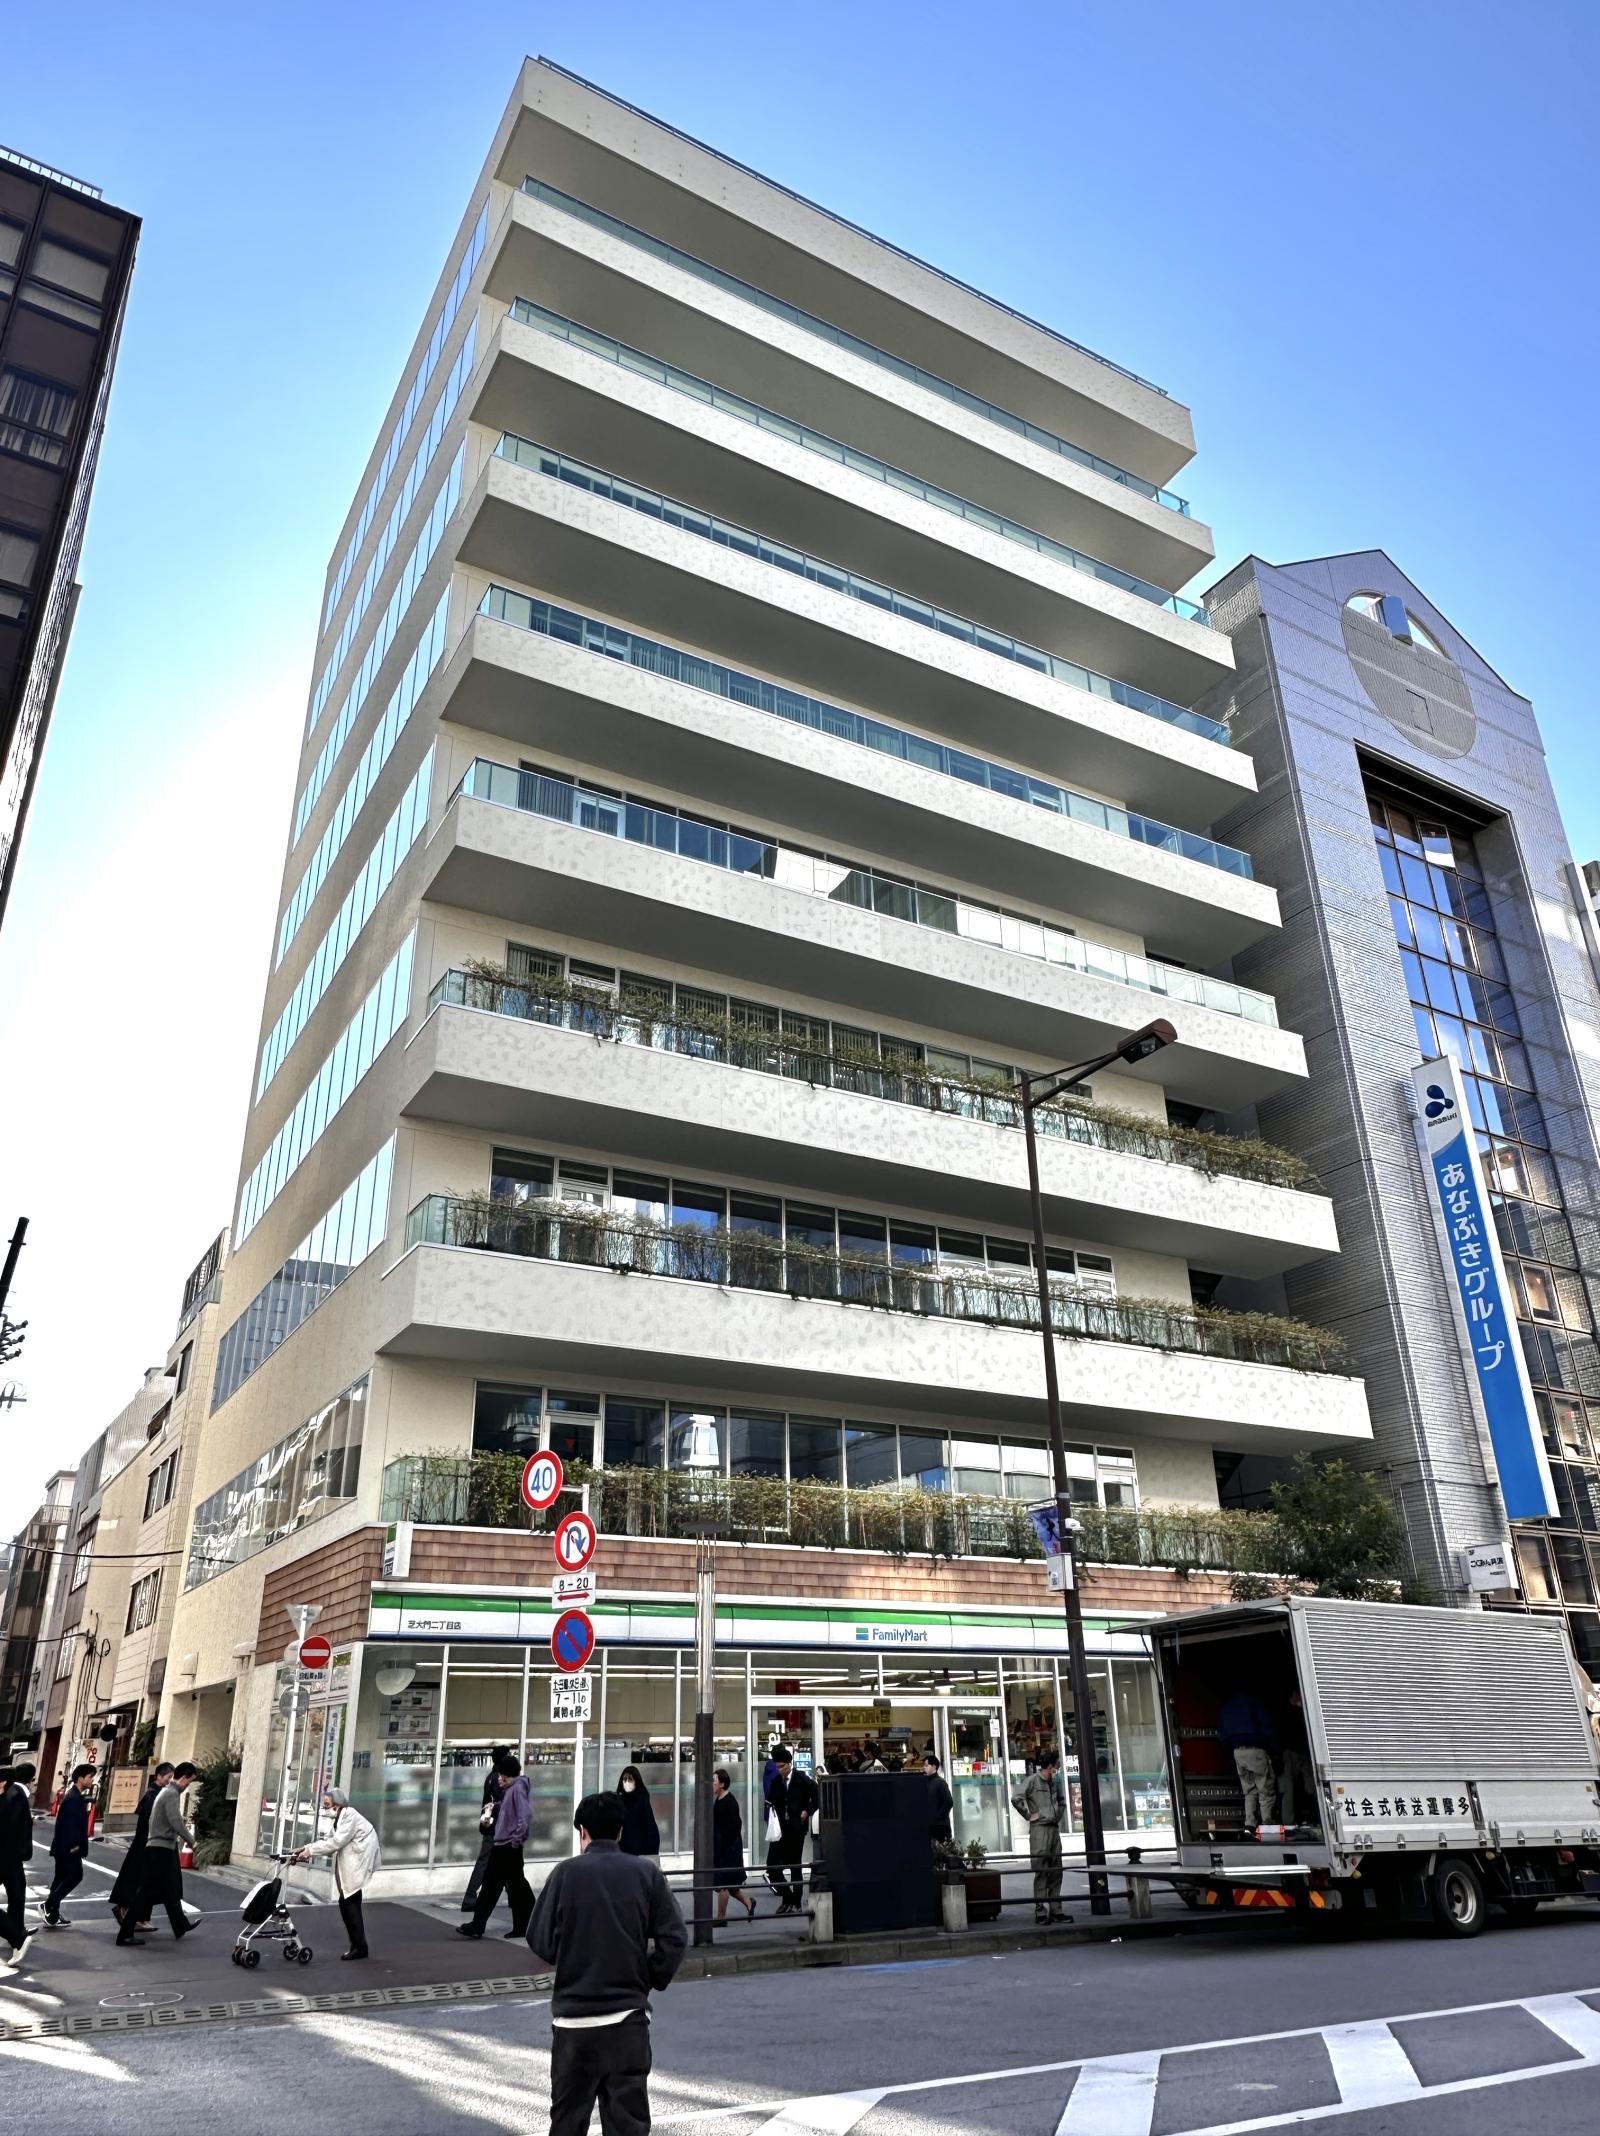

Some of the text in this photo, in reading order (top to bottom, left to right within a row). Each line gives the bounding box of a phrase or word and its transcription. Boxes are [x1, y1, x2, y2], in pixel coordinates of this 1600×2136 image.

[1440, 1162, 1505, 1371] あなぶきグループ
[530, 1466, 553, 1493] 40
[559, 1577, 589, 1591] 8-20
[407, 1619, 462, 1631] 芝大門二丁目店
[872, 1628, 928, 1642] FamilyMart
[553, 1705, 589, 1718] 貨物を除く
